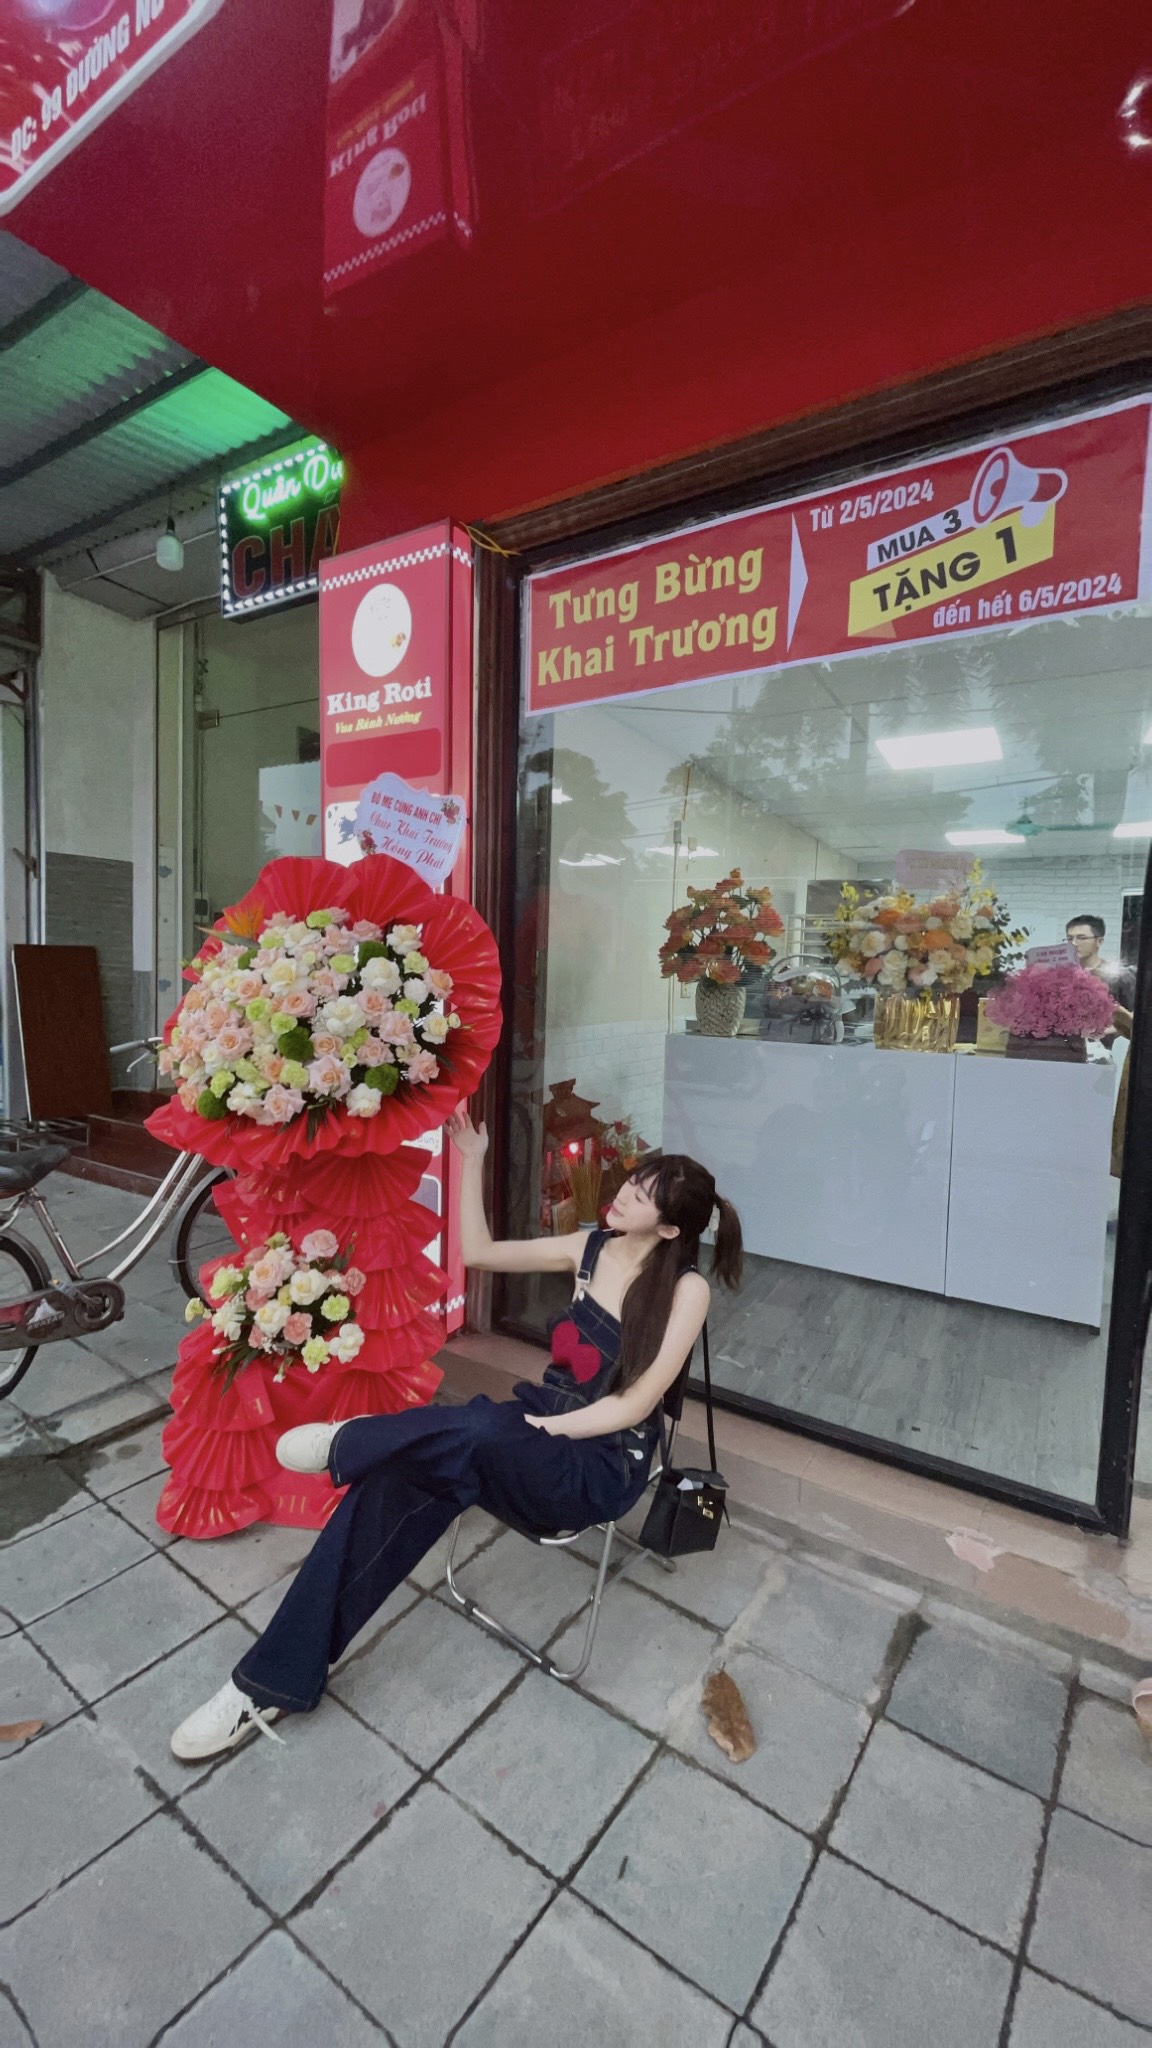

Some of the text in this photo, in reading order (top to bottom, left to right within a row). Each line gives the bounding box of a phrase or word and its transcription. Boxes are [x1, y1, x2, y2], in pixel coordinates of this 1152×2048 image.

[810, 479, 934, 532] Từ 2/5/2024
[877, 508, 963, 563] MUA 3
[549, 547, 764, 630] Tưng Bừng
[872, 526, 1018, 613] TẶNG 1
[933, 573, 1122, 628] đến hết 6/5/2024
[537, 605, 778, 687] Khai Trương
[326, 675, 432, 716] King Roti
[413, 806, 429, 822] ANH
